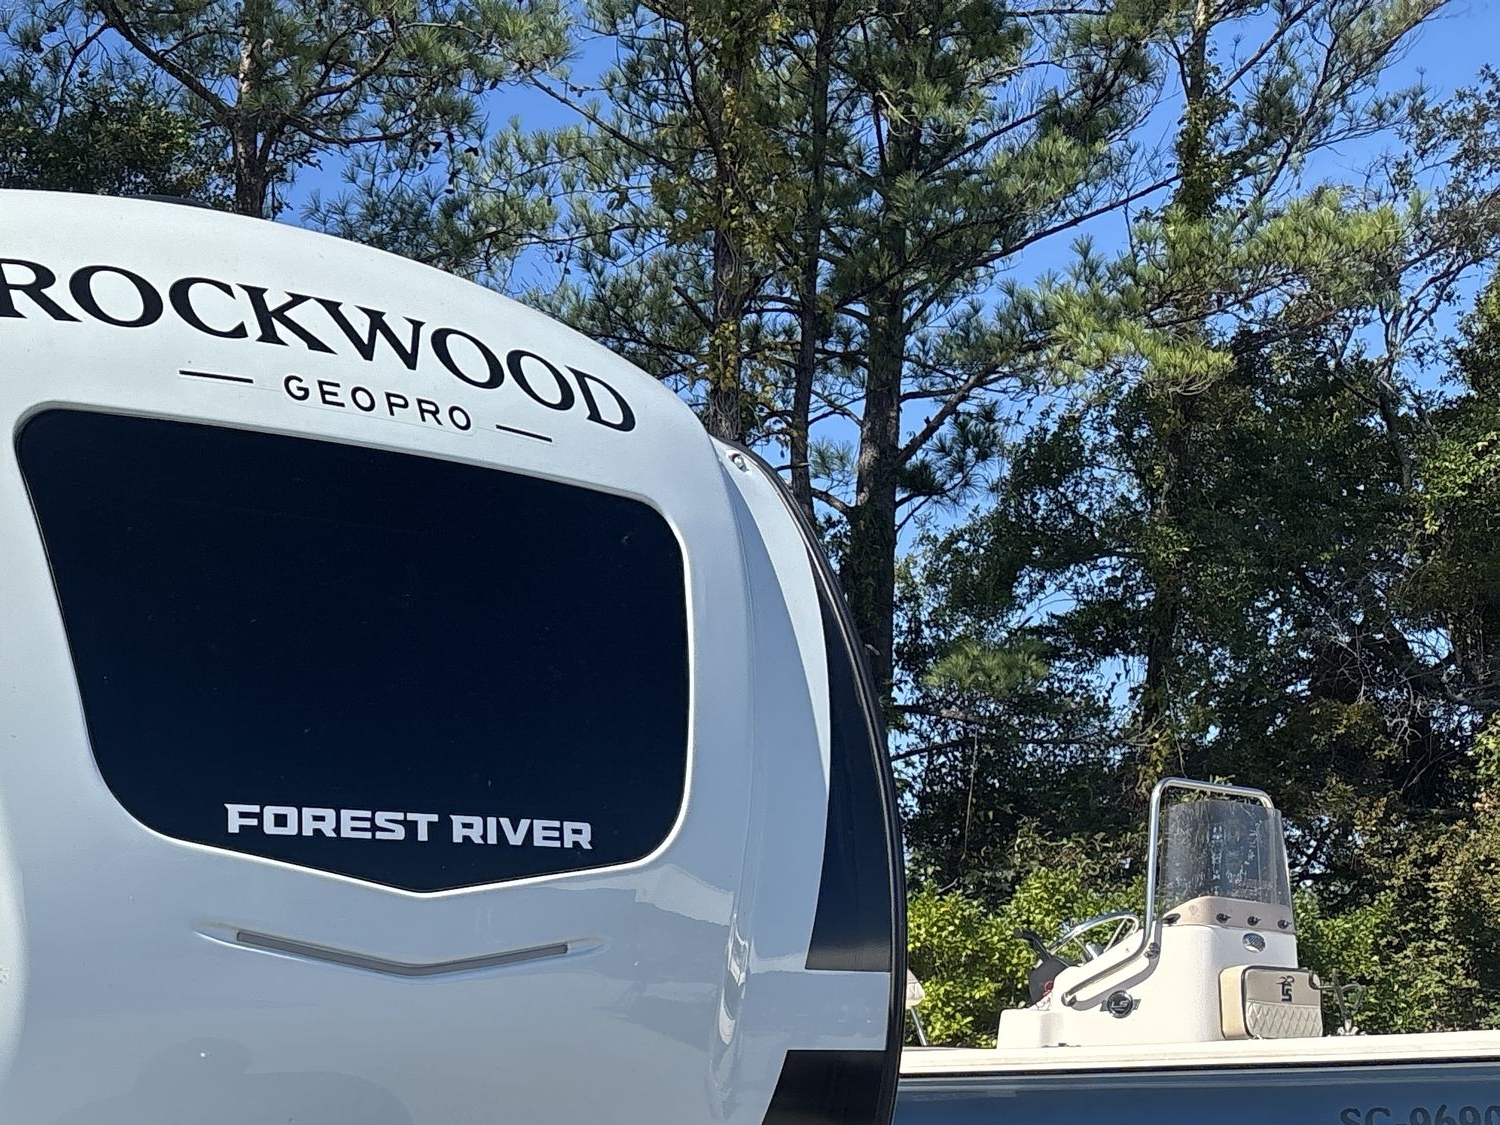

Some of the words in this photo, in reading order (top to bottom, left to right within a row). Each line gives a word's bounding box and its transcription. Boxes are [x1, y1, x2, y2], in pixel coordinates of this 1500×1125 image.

[283, 373, 473, 432] GEOPRO
[223, 802, 439, 842] FOREST
[449, 814, 594, 850] RIVER
